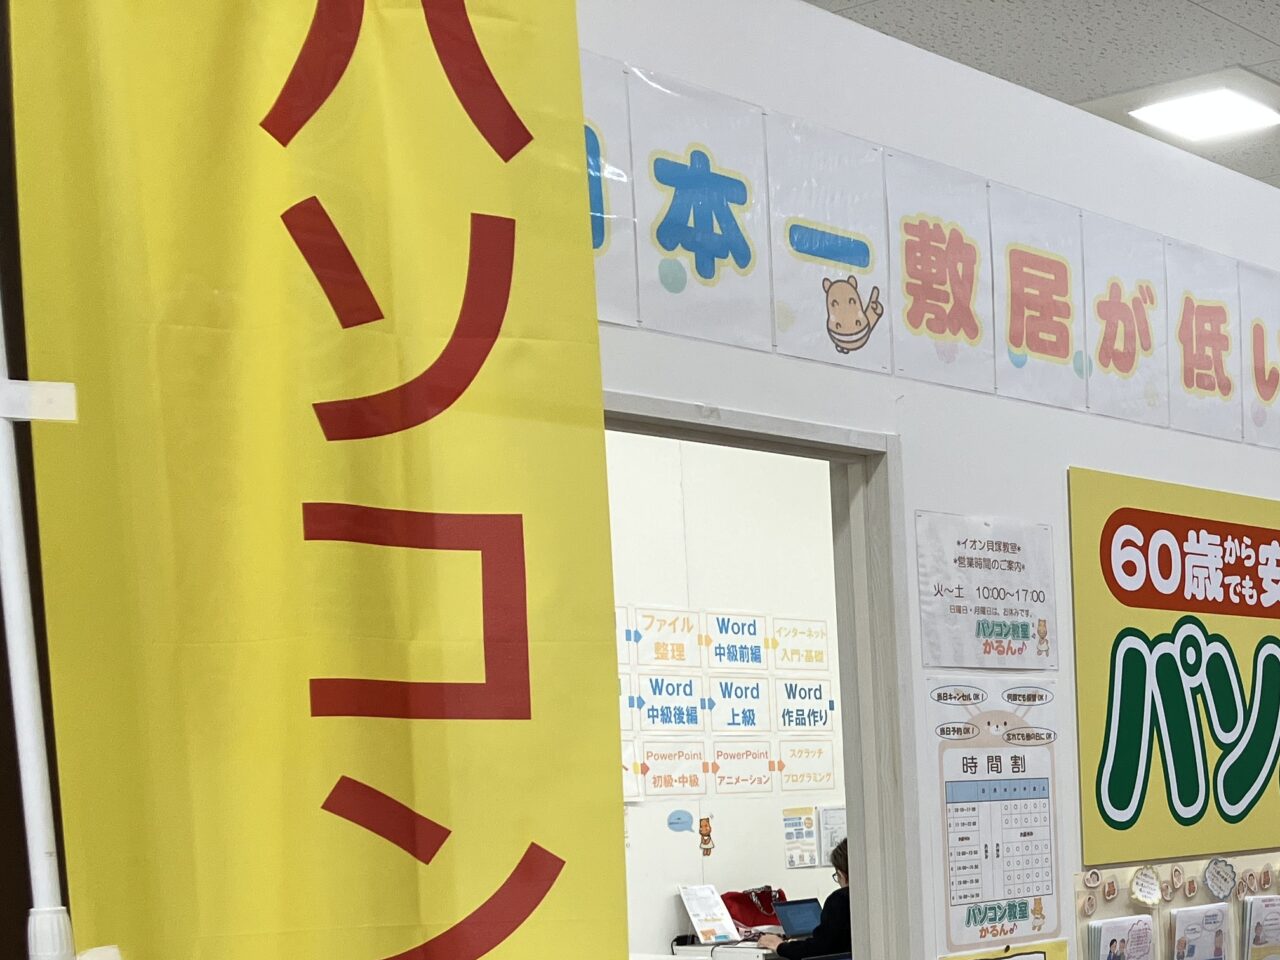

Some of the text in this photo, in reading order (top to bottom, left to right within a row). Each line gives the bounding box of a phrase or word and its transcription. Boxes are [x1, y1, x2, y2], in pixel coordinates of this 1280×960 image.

[641, 614, 694, 633] ファイル
[716, 617, 757, 636] Word
[654, 643, 686, 661] 整理
[714, 644, 762, 664] 中級前編
[649, 678, 693, 697] Word
[719, 681, 760, 700] Word
[784, 683, 822, 701] Word
[647, 705, 698, 725] 中級後編
[727, 707, 756, 727] 上級
[781, 707, 828, 727] 作品作り
[646, 751, 703, 761] PowerPoint
[717, 750, 769, 760] PowerPoint
[962, 754, 1026, 774] 時間割
[717, 775, 770, 786] アニメーション
[966, 900, 1030, 927] パソコン教室
